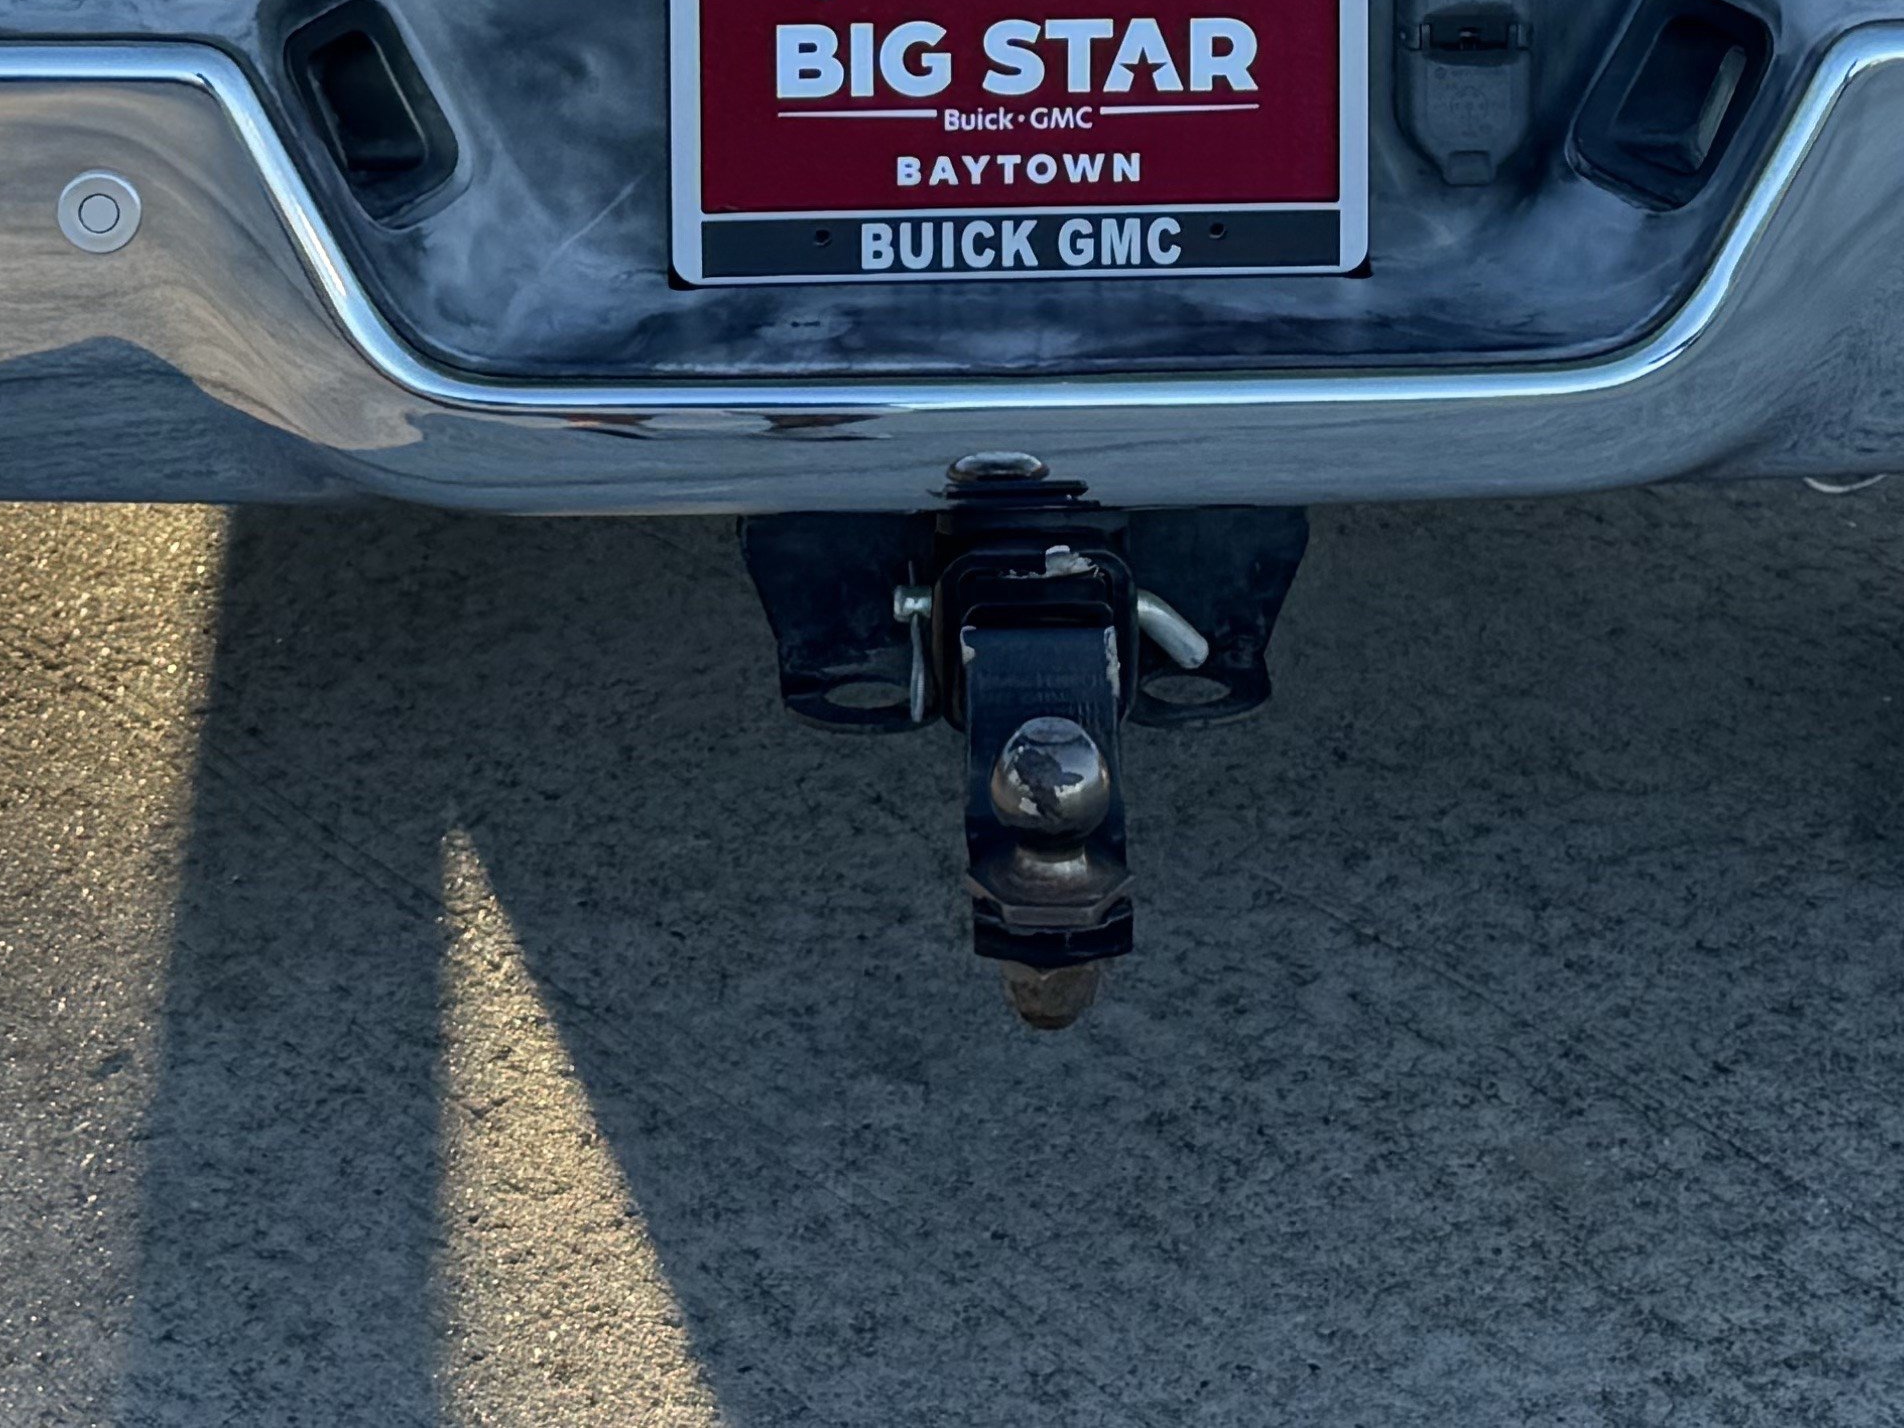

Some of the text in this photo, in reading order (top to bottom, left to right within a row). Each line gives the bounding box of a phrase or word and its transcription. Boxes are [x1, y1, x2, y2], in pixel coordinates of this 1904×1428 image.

[775, 17, 1259, 99] BIG STAR
[896, 152, 1141, 186] BAYTOWN
[860, 216, 1182, 270] BUICK GMC
